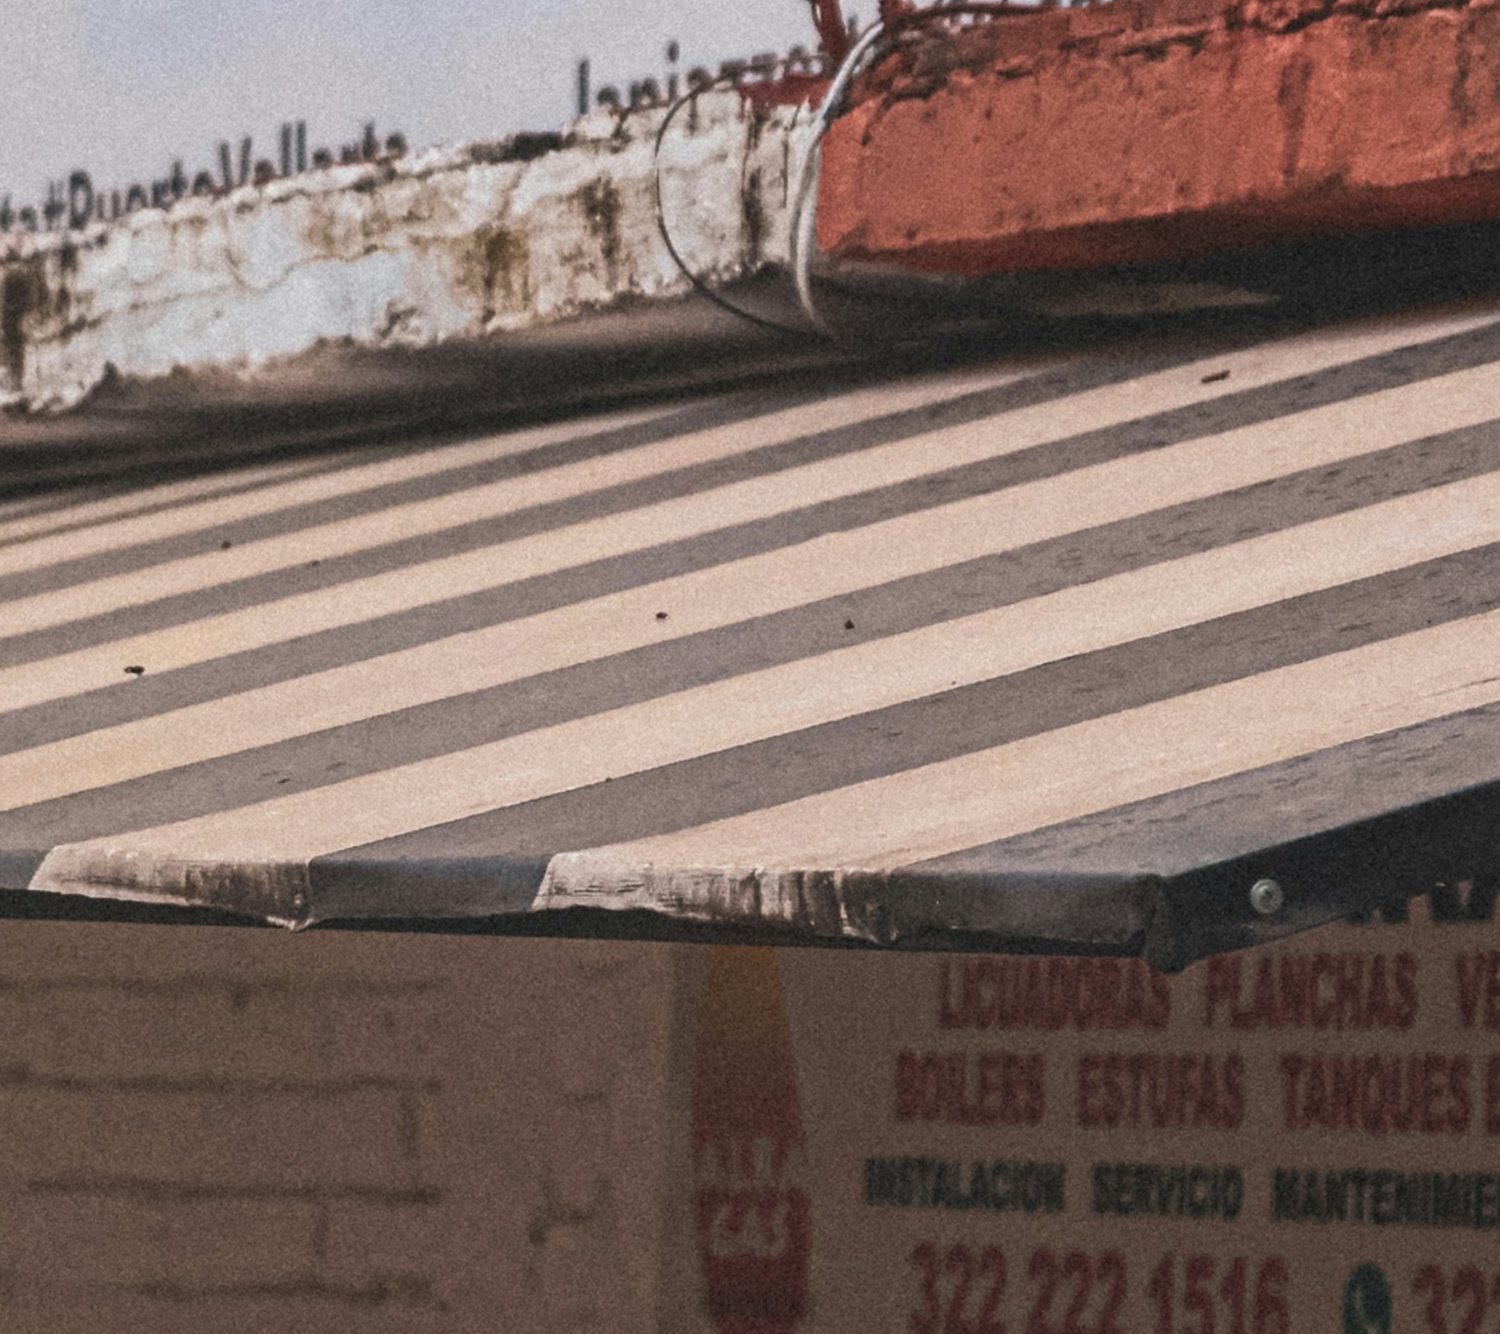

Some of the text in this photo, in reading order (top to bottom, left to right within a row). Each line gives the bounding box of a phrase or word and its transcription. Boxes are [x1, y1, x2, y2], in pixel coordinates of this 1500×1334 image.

[1203, 950, 1419, 1030] PLANCHAS
[895, 1049, 1044, 1127] BOILERS
[1077, 1052, 1246, 1132] ESTUFAS
[1280, 1053, 1472, 1137] TANQUES
[864, 1158, 1066, 1212] INSTALACION
[1092, 1162, 1246, 1221] SERVICIO
